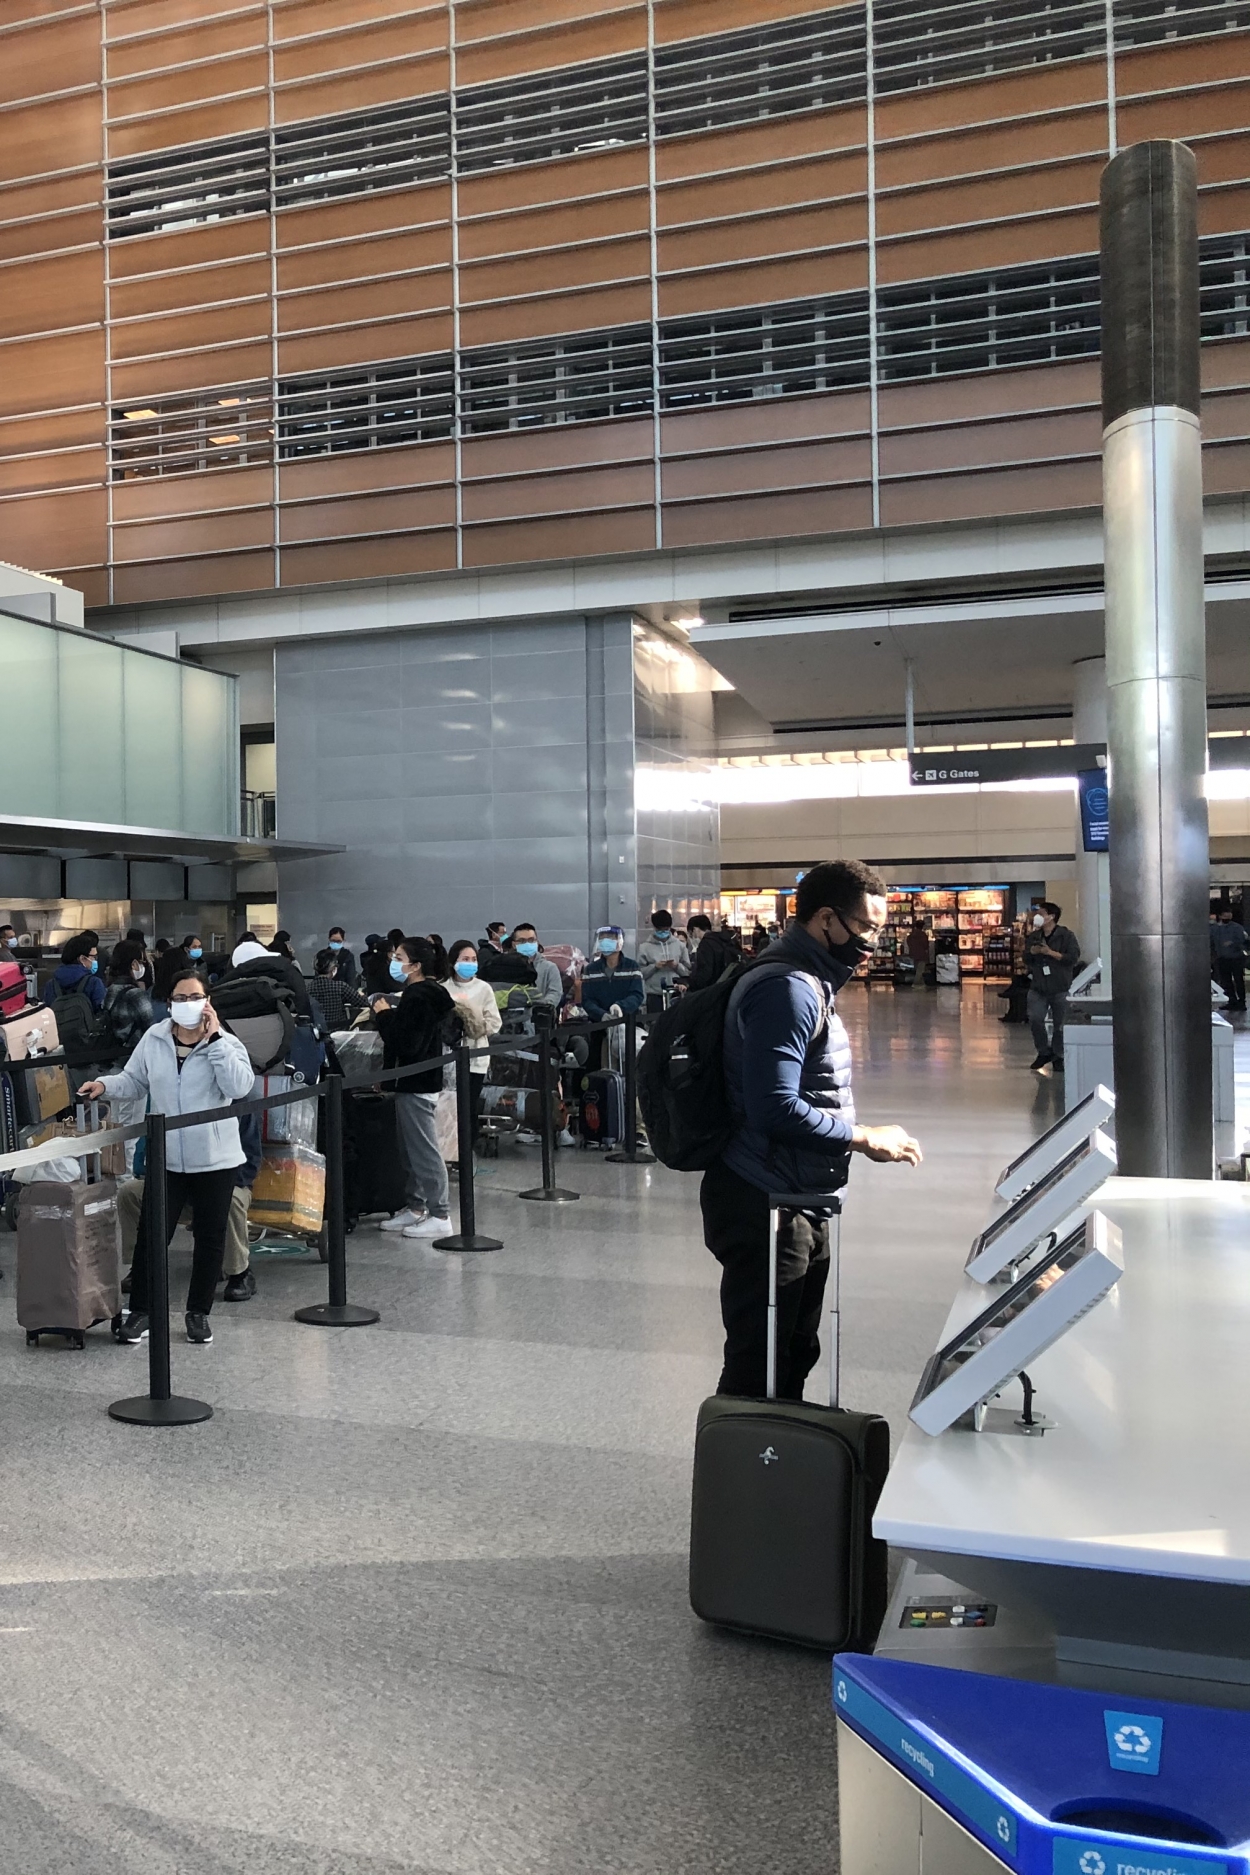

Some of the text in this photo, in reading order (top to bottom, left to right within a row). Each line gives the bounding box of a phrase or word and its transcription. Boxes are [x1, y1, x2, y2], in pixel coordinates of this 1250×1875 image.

[938, 769, 980, 779] G Gates
[901, 1738, 934, 1778] recycling
